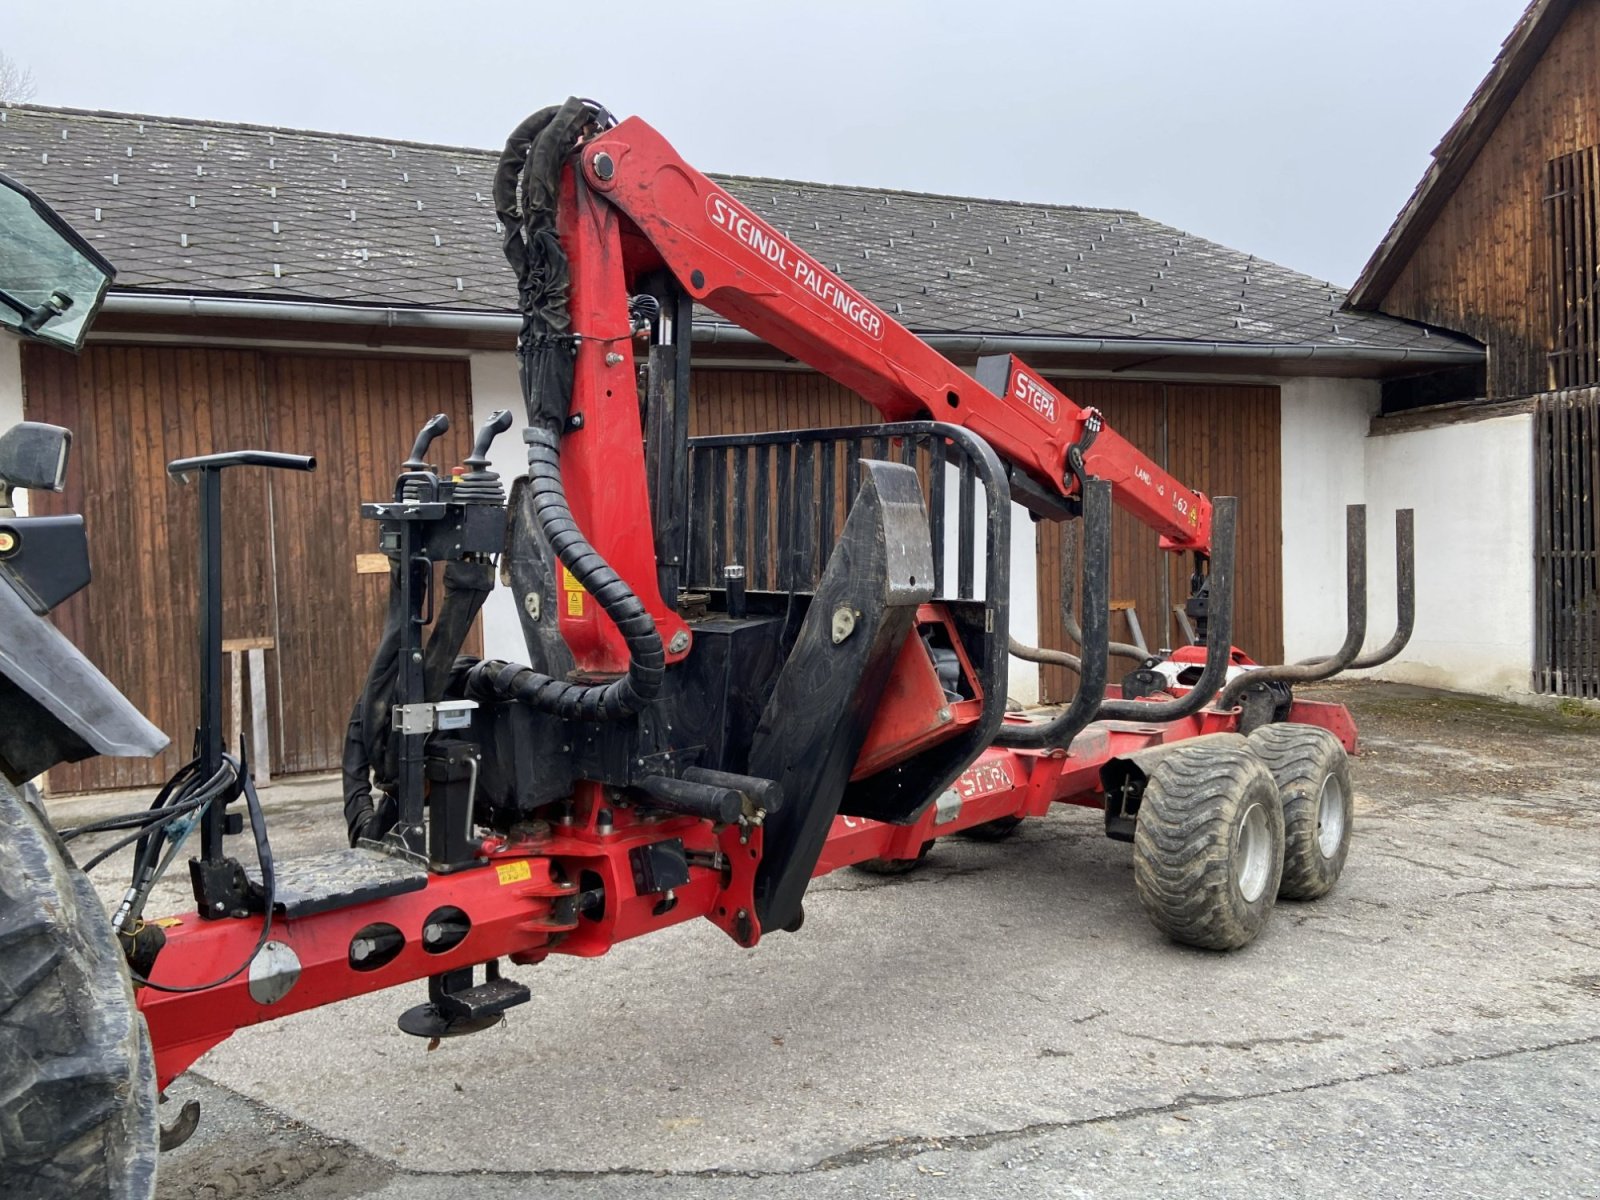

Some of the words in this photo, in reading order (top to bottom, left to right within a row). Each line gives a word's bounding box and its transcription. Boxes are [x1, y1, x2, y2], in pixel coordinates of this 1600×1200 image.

[711, 198, 881, 337] STEINDL-PALFINGER
[1015, 372, 1055, 421] STEPA
[960, 766, 1012, 796] STPA
